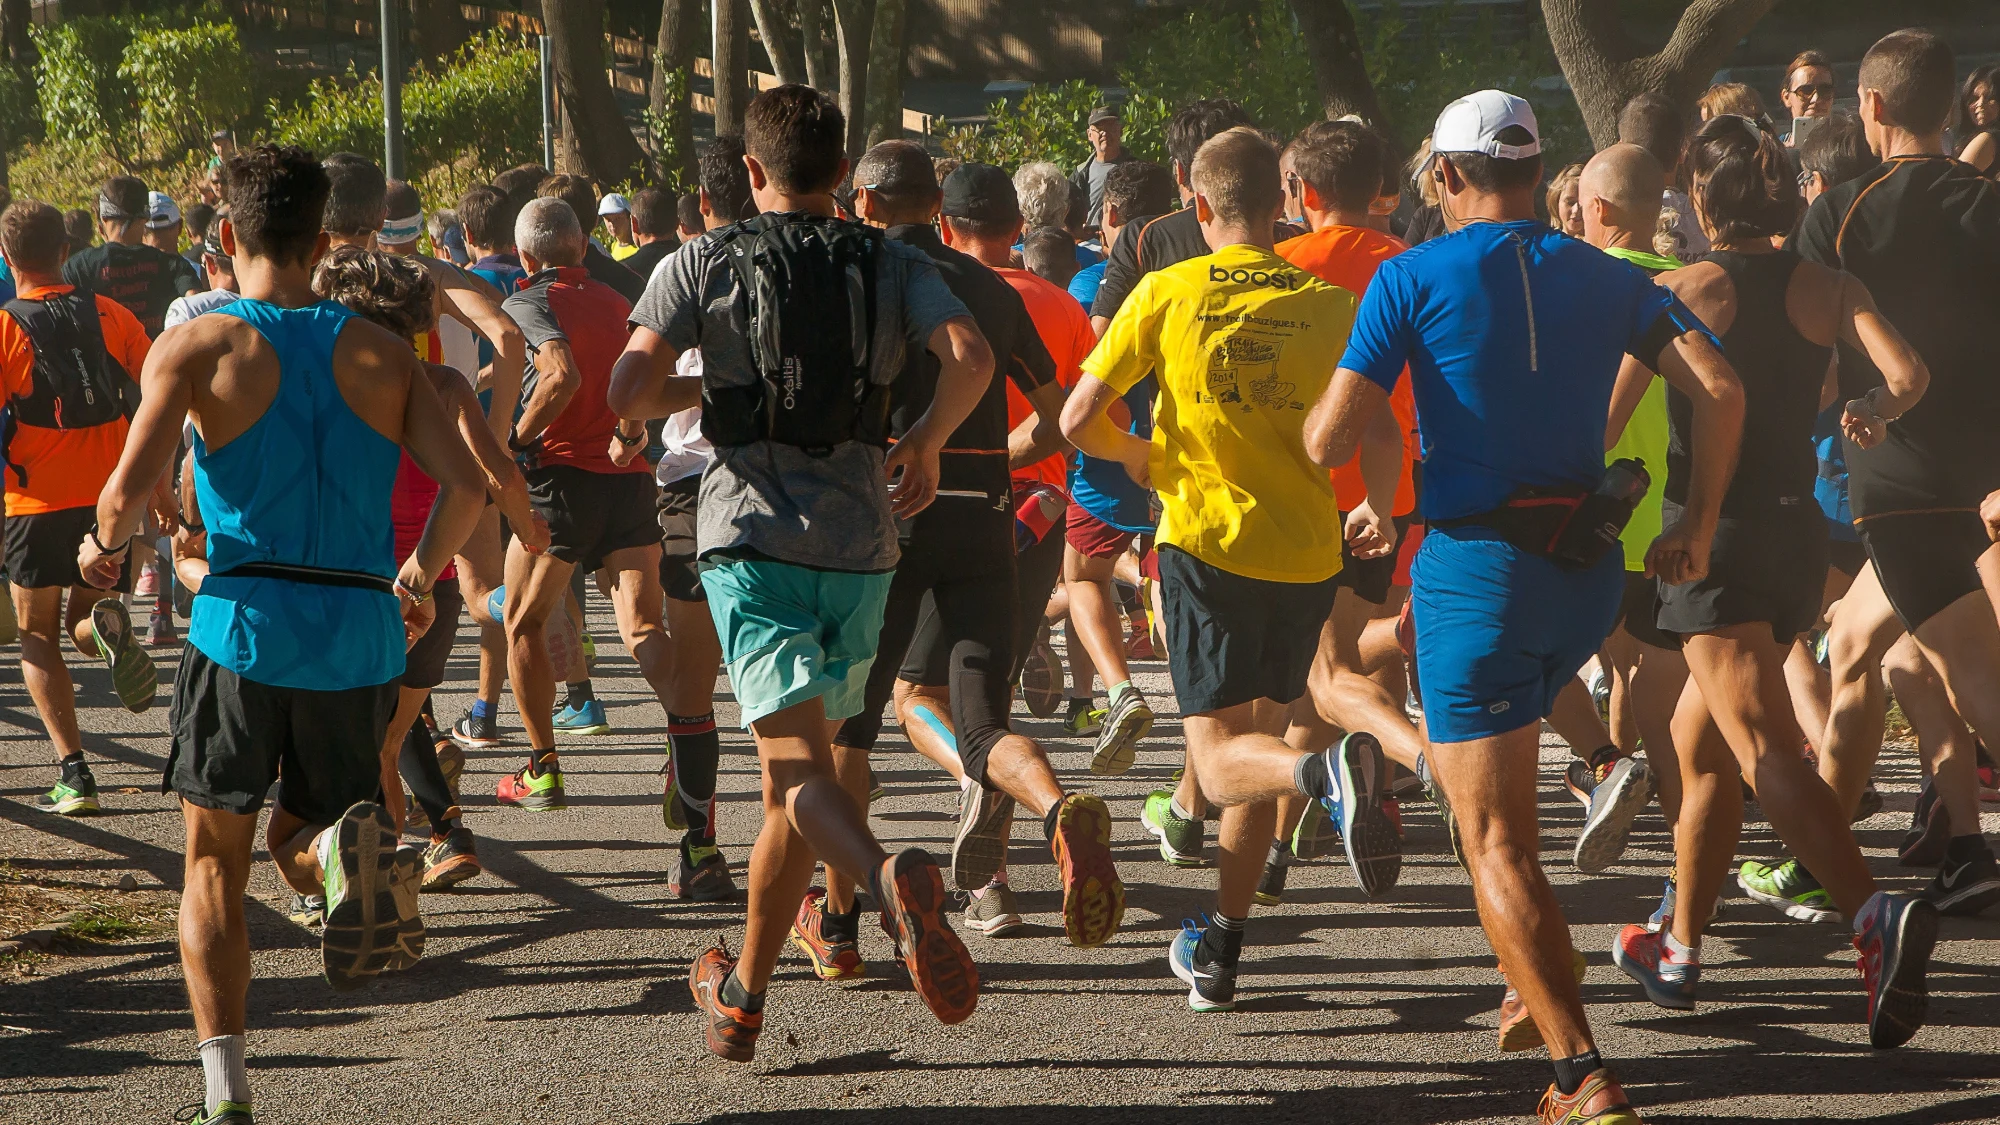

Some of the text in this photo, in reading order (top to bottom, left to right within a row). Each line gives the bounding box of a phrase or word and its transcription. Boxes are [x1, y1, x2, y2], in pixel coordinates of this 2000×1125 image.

[1209, 264, 1299, 291] boost
[1197, 313, 1312, 331] www.trailbouzigues.fr
[1212, 371, 1235, 384] 2014
